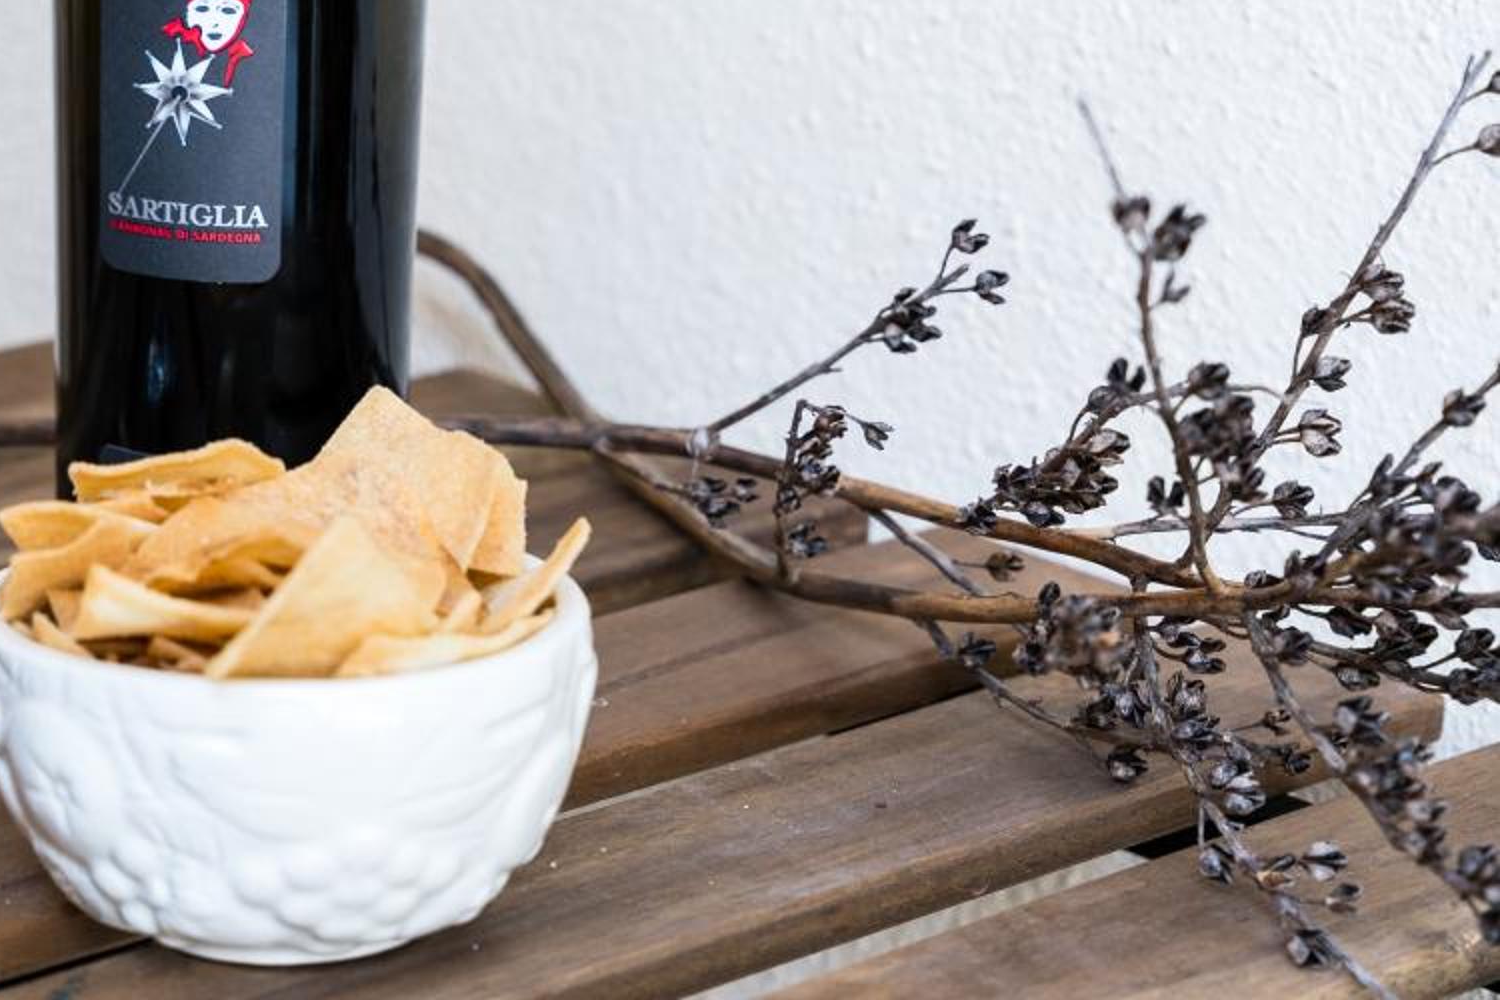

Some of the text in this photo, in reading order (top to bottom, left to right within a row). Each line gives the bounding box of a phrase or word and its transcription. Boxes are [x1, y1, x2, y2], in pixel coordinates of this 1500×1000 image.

[108, 193, 268, 228] SARTIGLIA
[175, 228, 190, 241] DI
[192, 230, 262, 245] SARDEGNA
